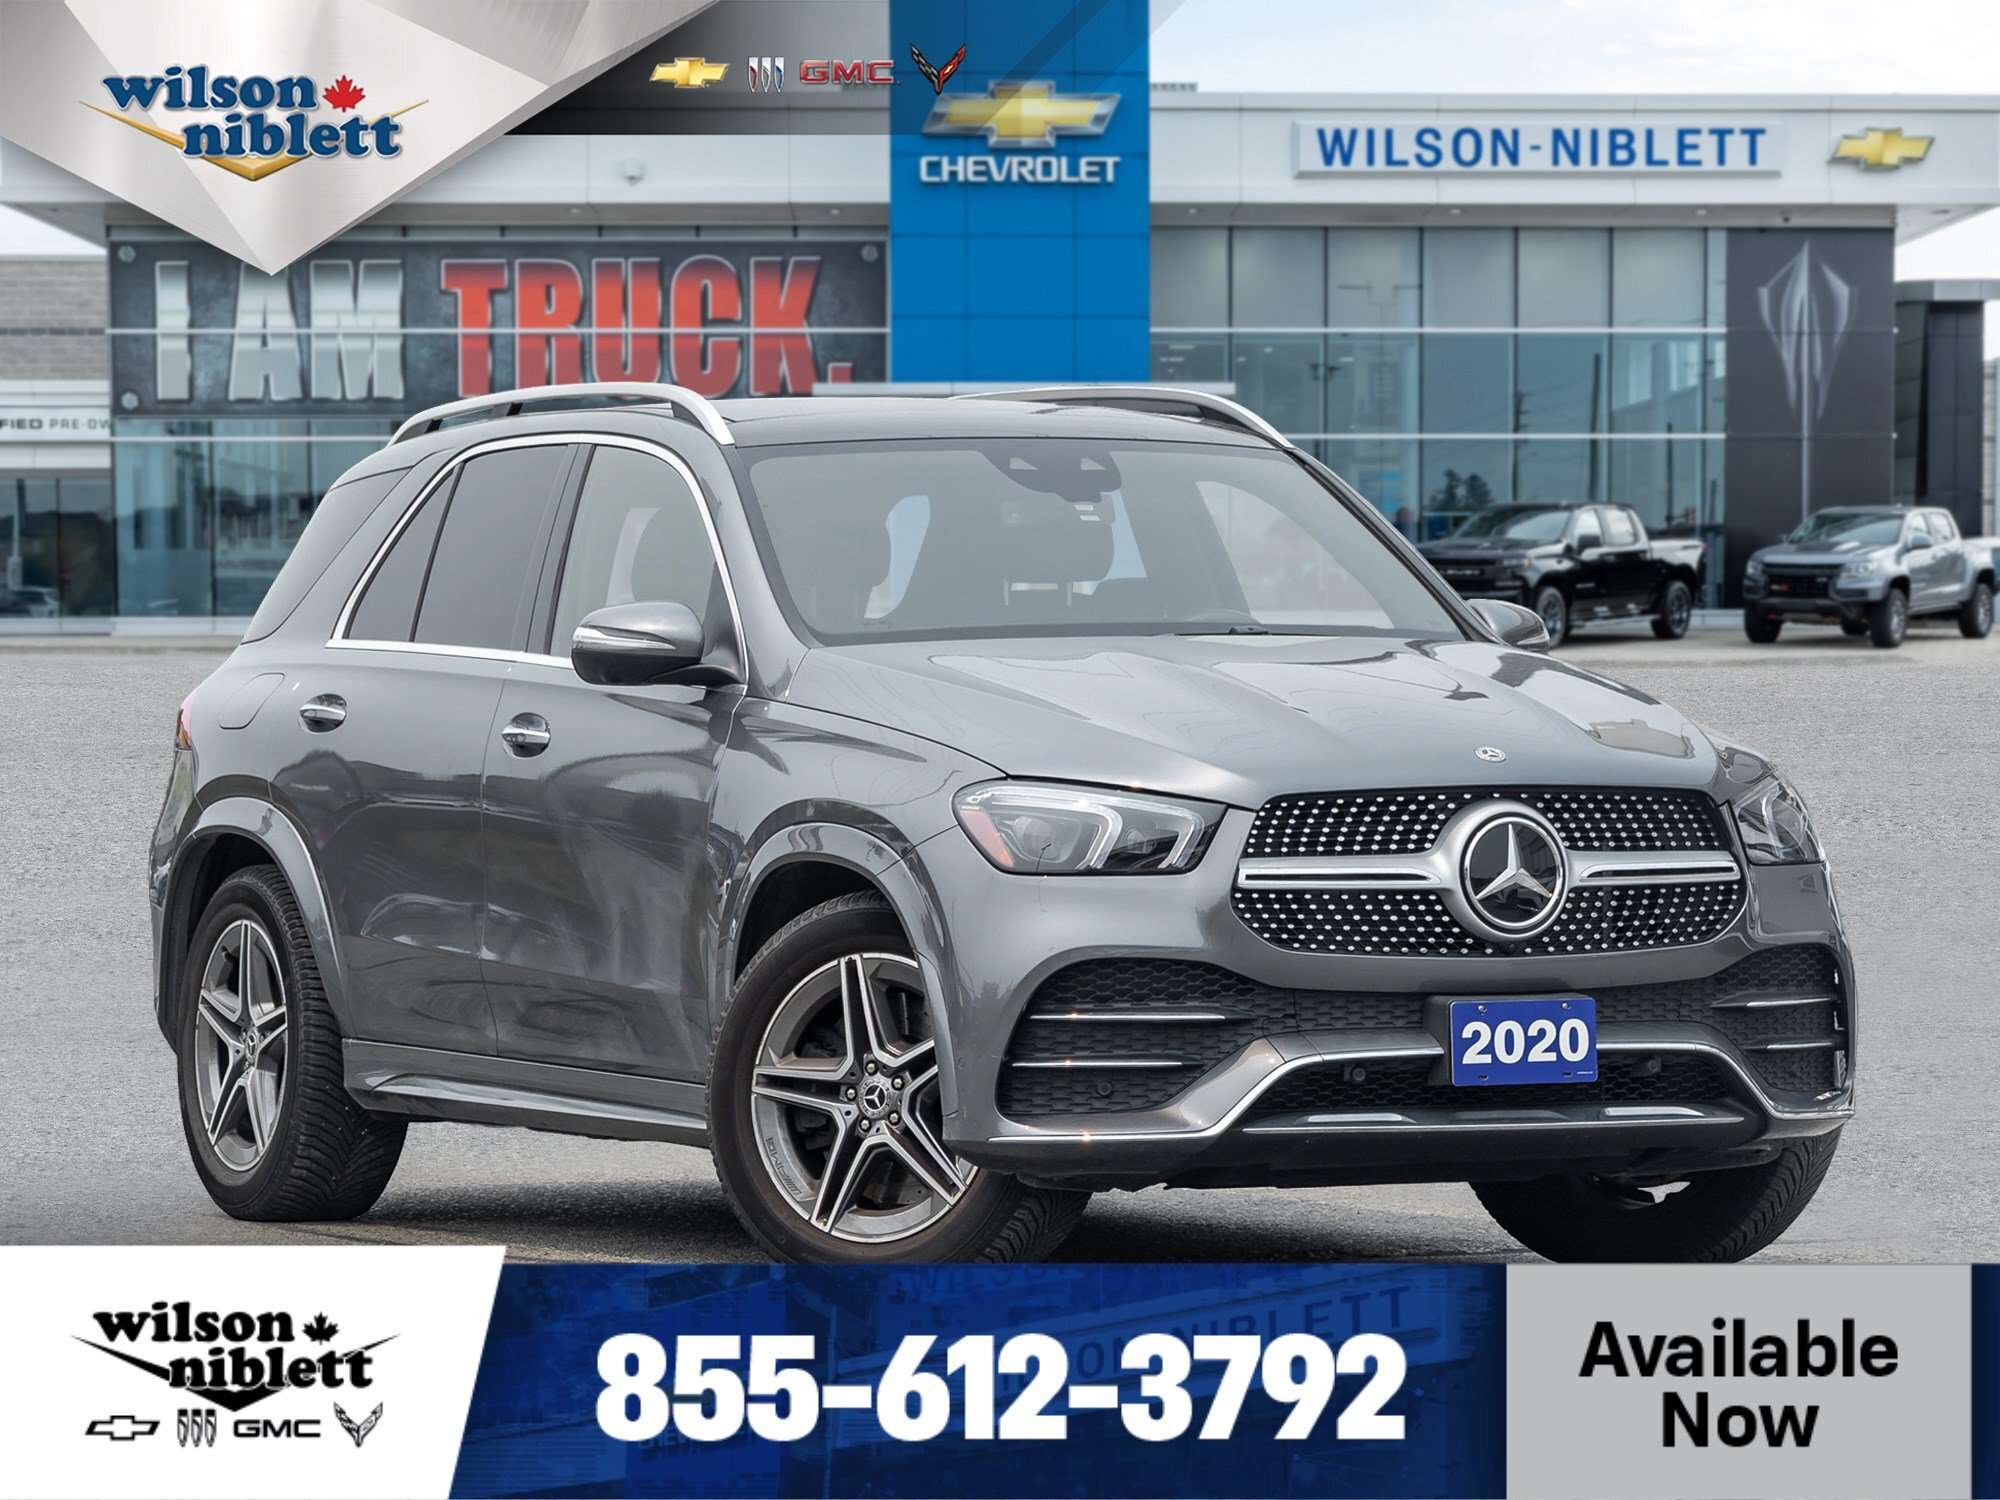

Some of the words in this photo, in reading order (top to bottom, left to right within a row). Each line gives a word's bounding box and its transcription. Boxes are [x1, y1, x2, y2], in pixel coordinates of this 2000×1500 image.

[919, 155, 1121, 183] CHEVROLET
[1316, 127, 1767, 168] WILSON-NIBLETT
[155, 261, 190, 400] I
[228, 259, 405, 400] AM
[1461, 1018, 1589, 1064] 2020
